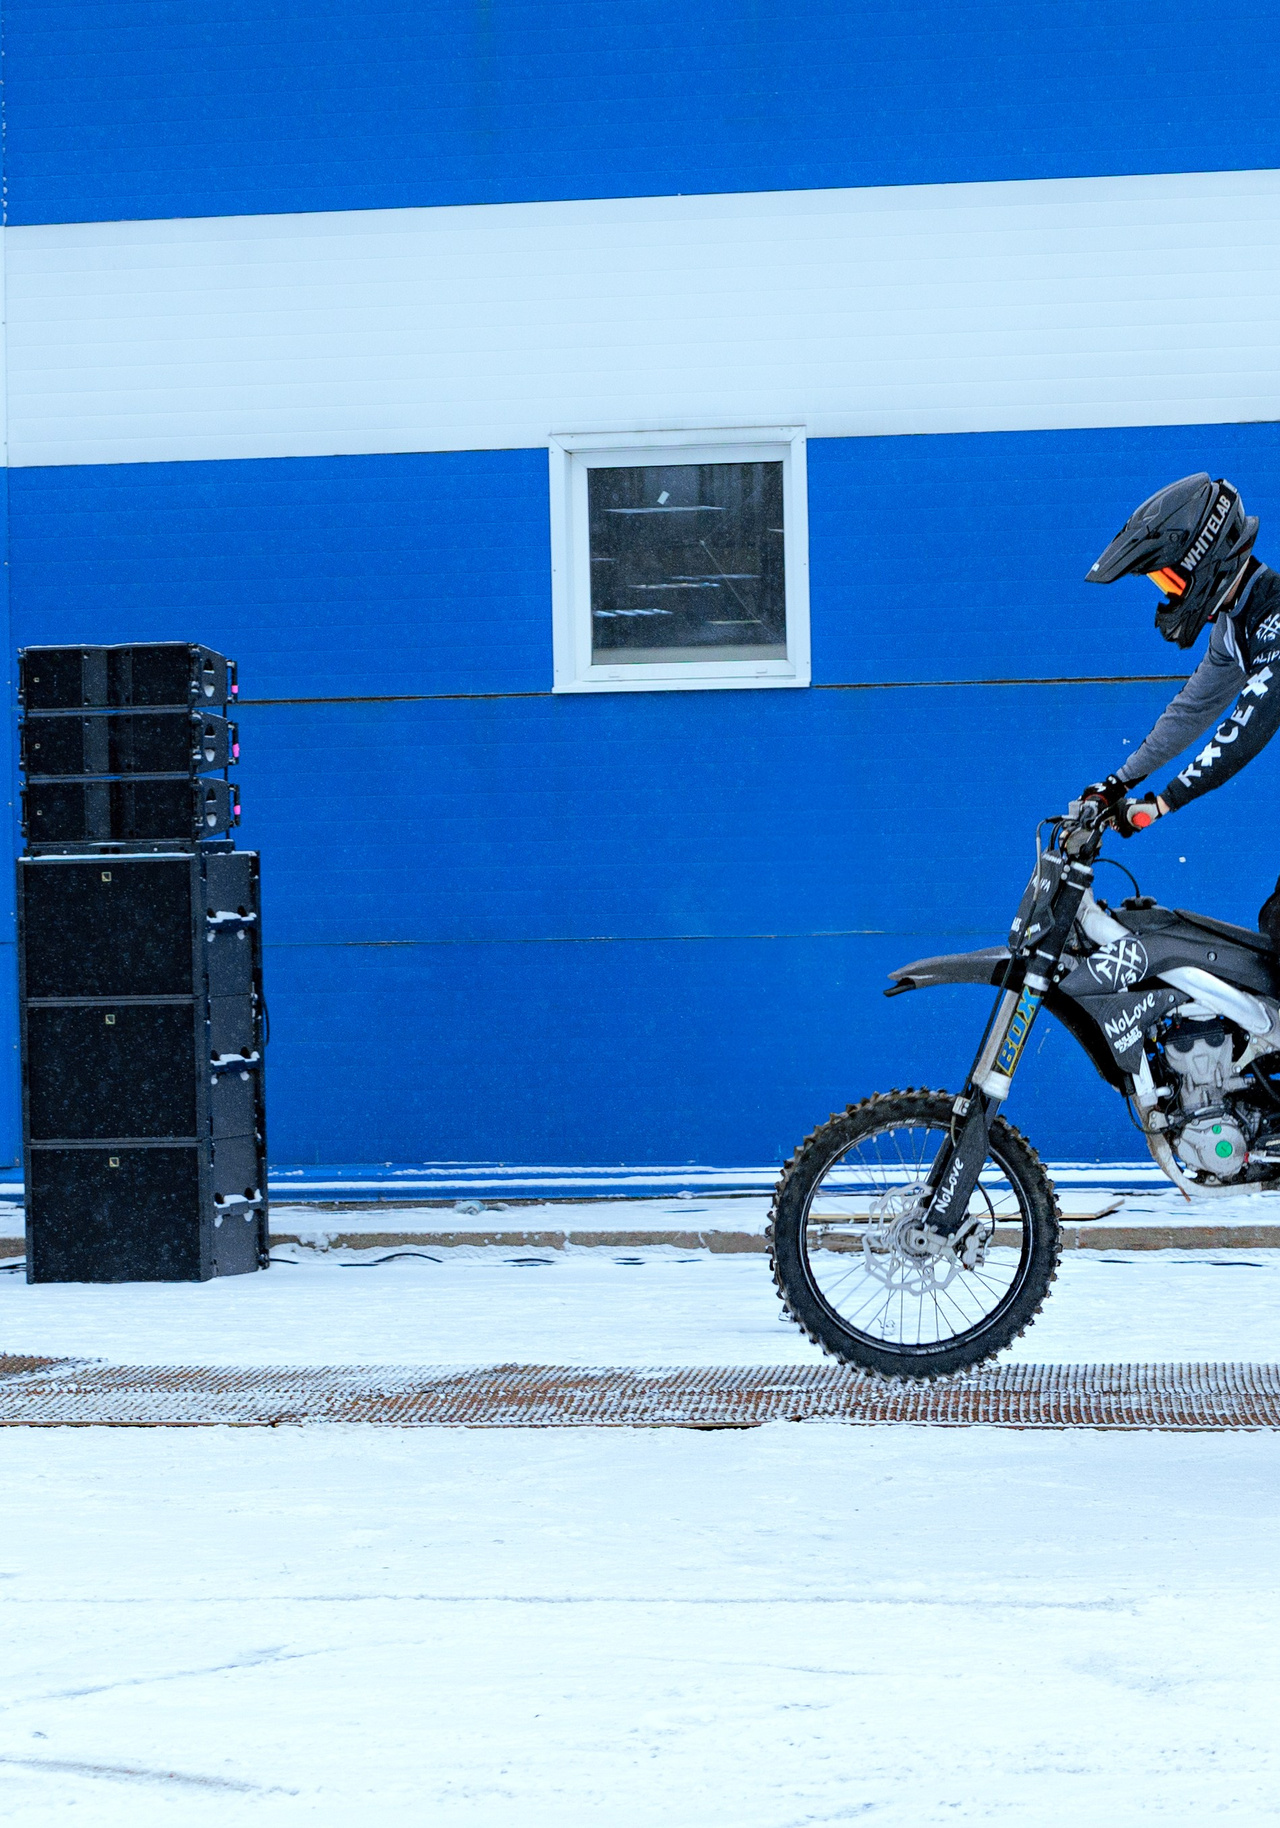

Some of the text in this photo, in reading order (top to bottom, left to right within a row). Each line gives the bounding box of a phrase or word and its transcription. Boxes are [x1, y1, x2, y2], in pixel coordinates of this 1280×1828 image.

[1180, 495, 1231, 571] WHITELAB
[1104, 992, 1156, 1039] NoLove
[934, 1157, 964, 1214] NoLove
